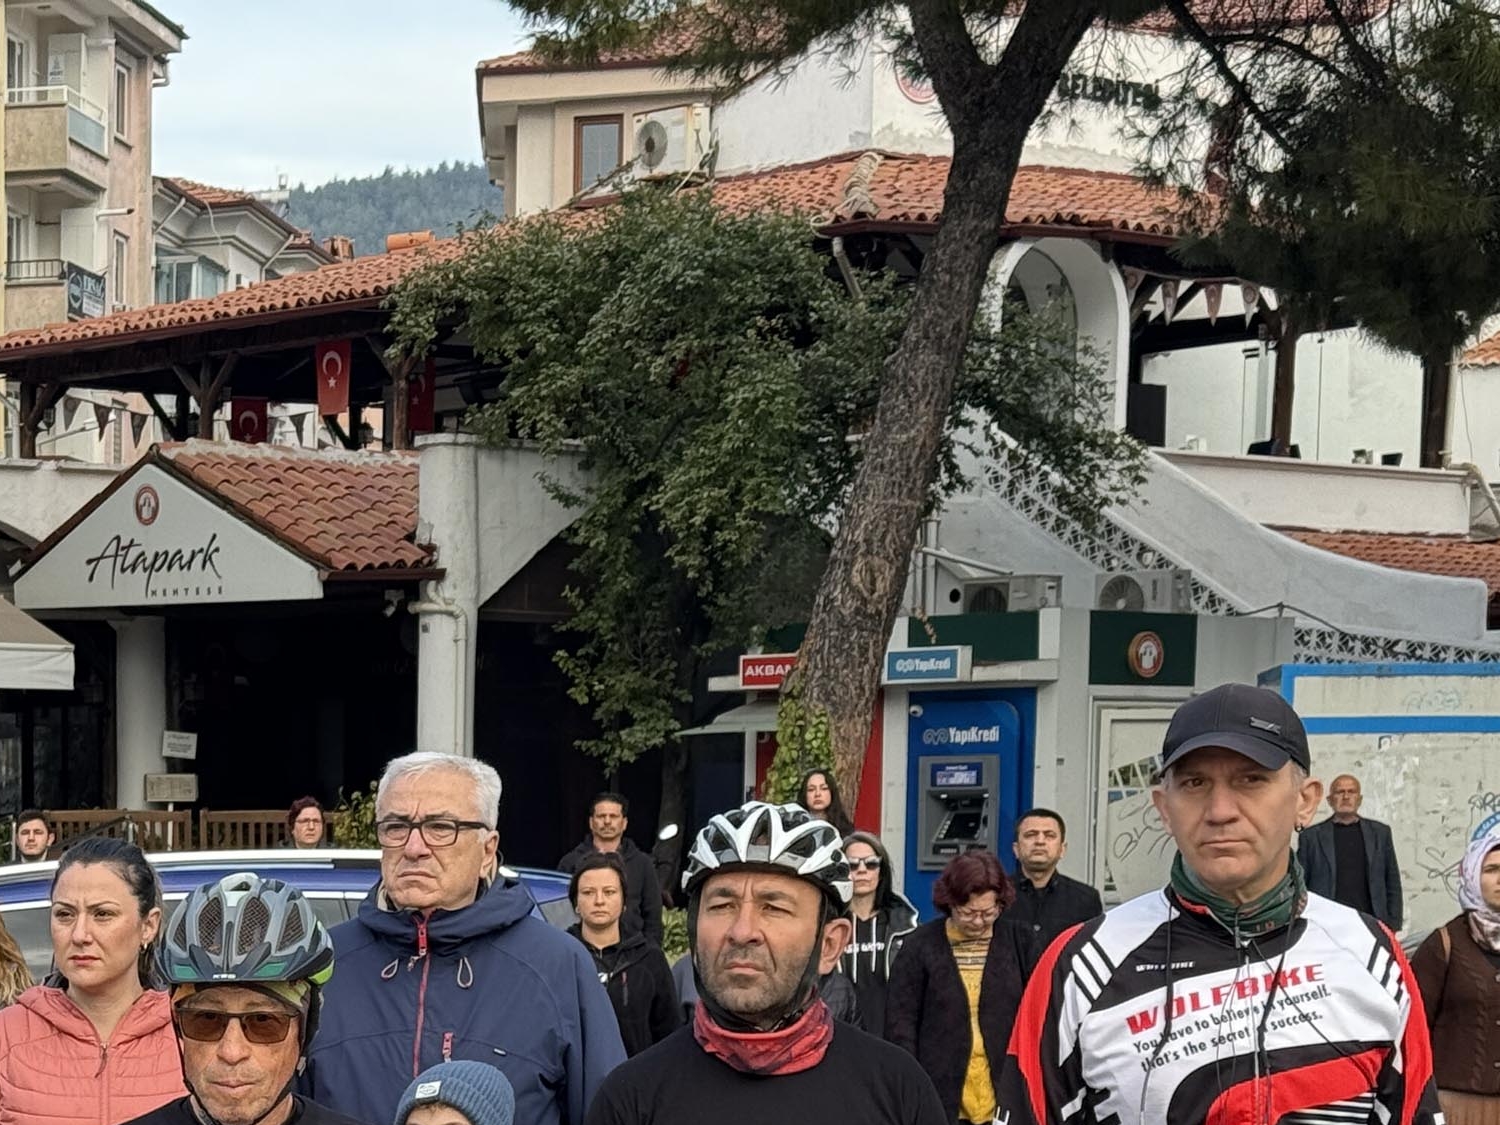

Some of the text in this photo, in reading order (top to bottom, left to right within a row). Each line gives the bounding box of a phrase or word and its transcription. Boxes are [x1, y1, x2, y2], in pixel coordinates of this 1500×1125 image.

[86, 533, 222, 598] Atapark
[744, 664, 794, 678] AKBAN
[1194, 1019, 1210, 1032] to
[1183, 1041, 1207, 1057] the
